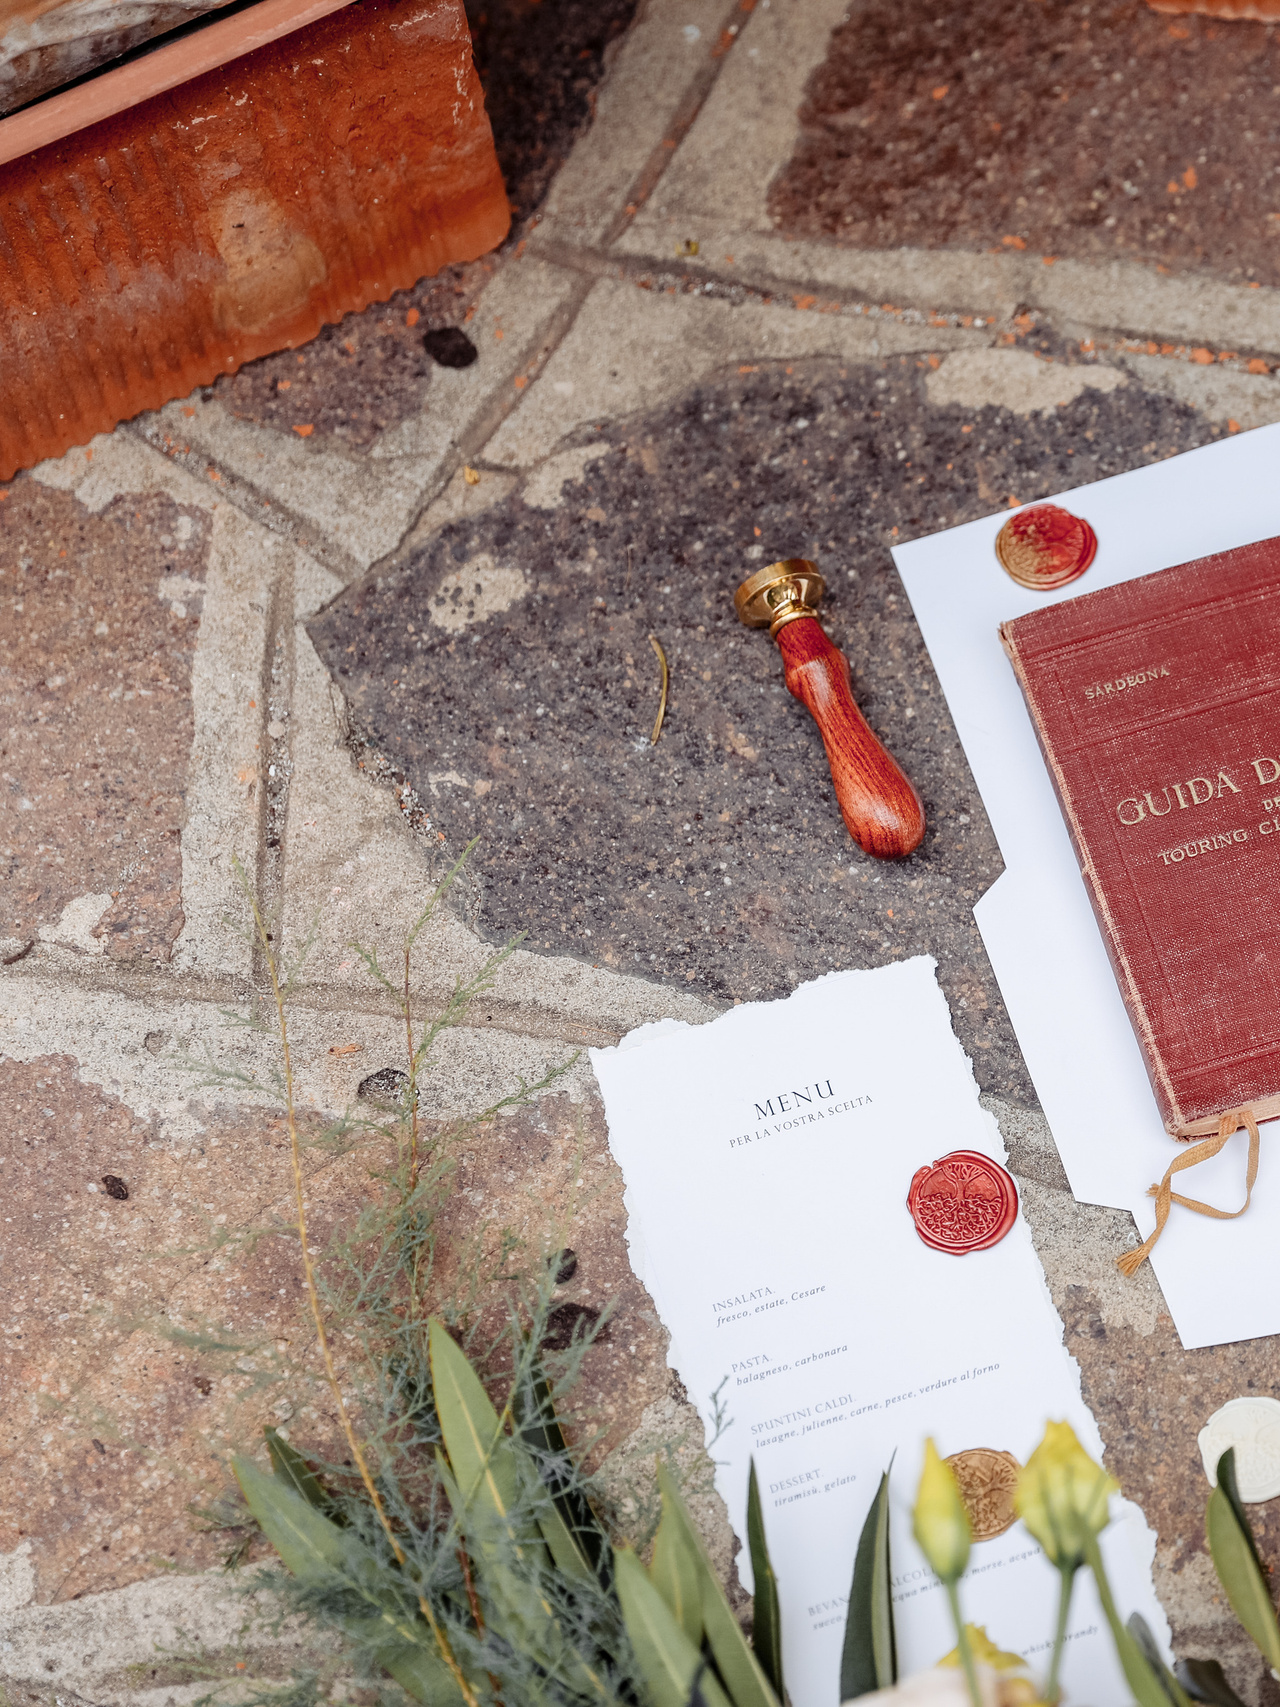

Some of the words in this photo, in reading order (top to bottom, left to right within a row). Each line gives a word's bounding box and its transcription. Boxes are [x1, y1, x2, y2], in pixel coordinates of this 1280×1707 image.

[1084, 665, 1170, 700] SARDEGNA
[1116, 771, 1242, 826] GUIDA
[1157, 828, 1249, 866] TOURING
[753, 1079, 835, 1121] MENU
[729, 1134, 753, 1149] PER
[754, 1128, 771, 1140] LA
[773, 1110, 825, 1133] VOSTRA
[827, 1094, 873, 1117] SCELTA
[790, 1285, 826, 1302] Cesare
[794, 1344, 848, 1368] carbonara
[918, 1376, 958, 1395] verdure
[959, 1370, 972, 1382] al
[972, 1362, 1001, 1380] forno
[750, 1407, 812, 1436] SPUNTINI
[823, 1474, 857, 1493] gelato
